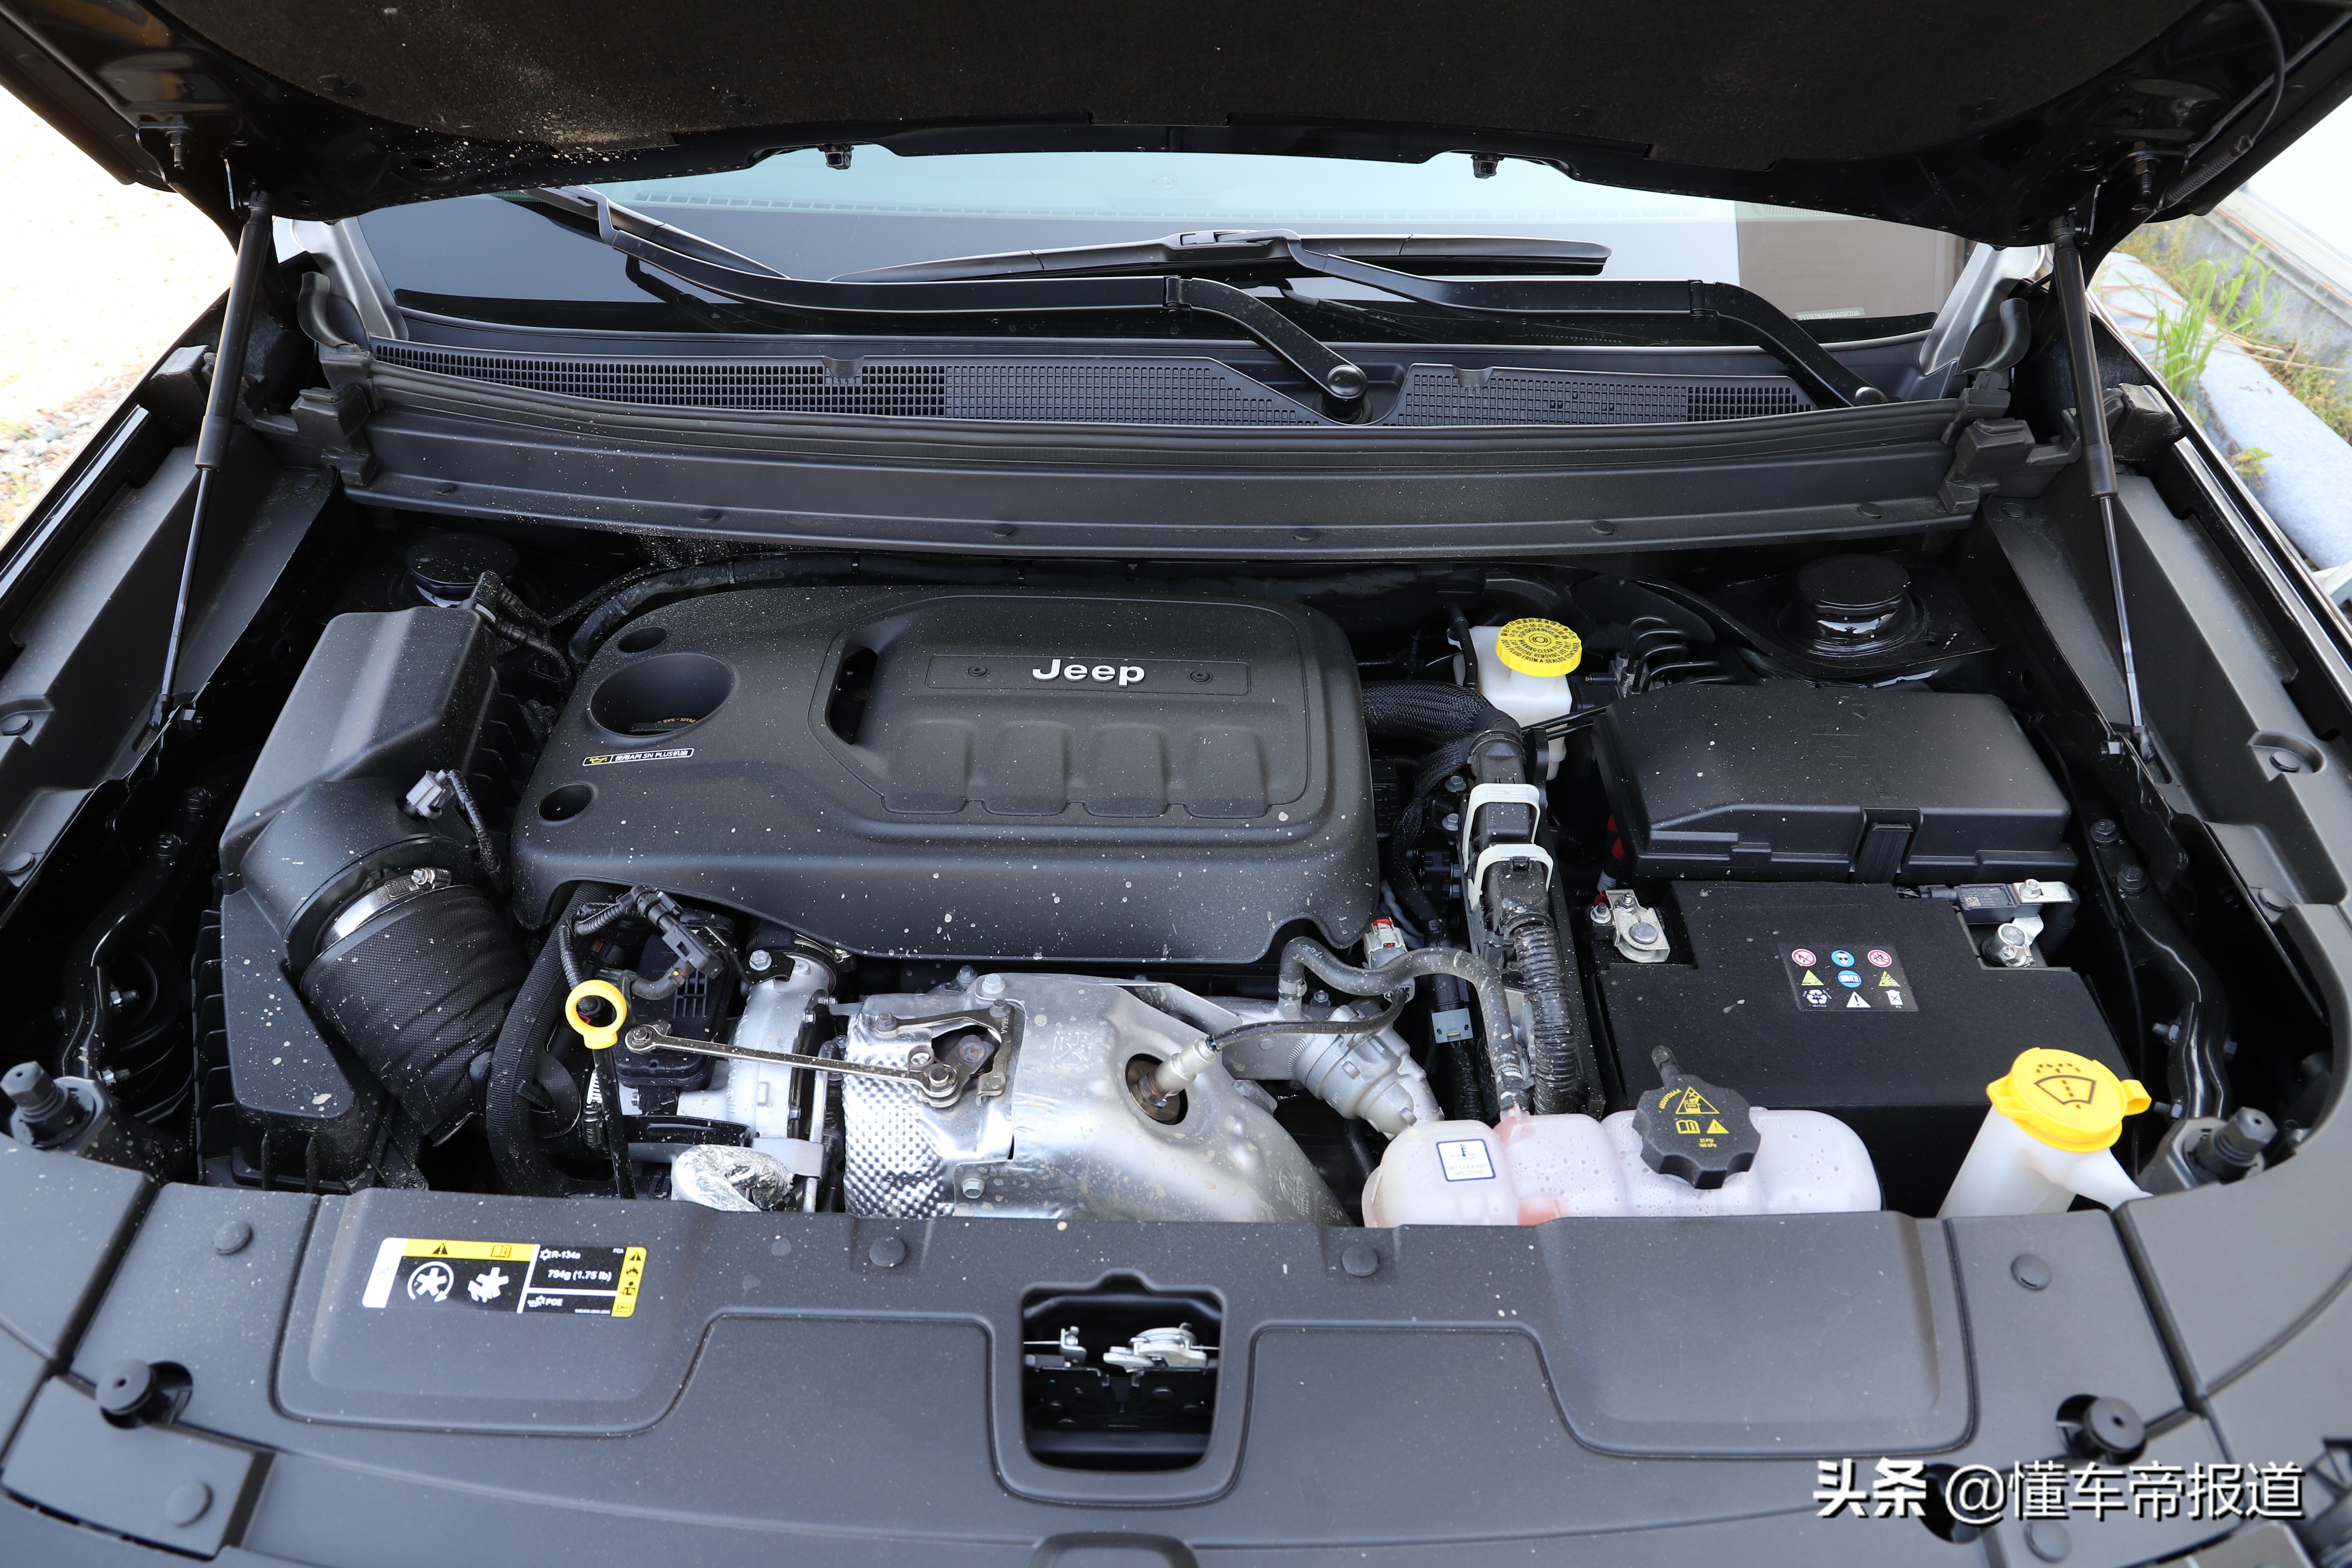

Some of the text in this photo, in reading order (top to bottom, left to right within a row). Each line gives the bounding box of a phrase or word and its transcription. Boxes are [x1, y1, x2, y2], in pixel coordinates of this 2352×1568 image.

[1501, 640, 1510, 648] DOT4
[1508, 647, 1522, 657] FLUID
[1566, 642, 1580, 659] CONTAINER
[1515, 645, 1533, 656] BEFORE
[1553, 641, 1563, 651] FILLER
[1032, 659, 1145, 688] Jeep
[551, 1250, 581, 1259] R-134a
[548, 1269, 612, 1282] 794g (1.75 lb)
[545, 1298, 564, 1307] POE
